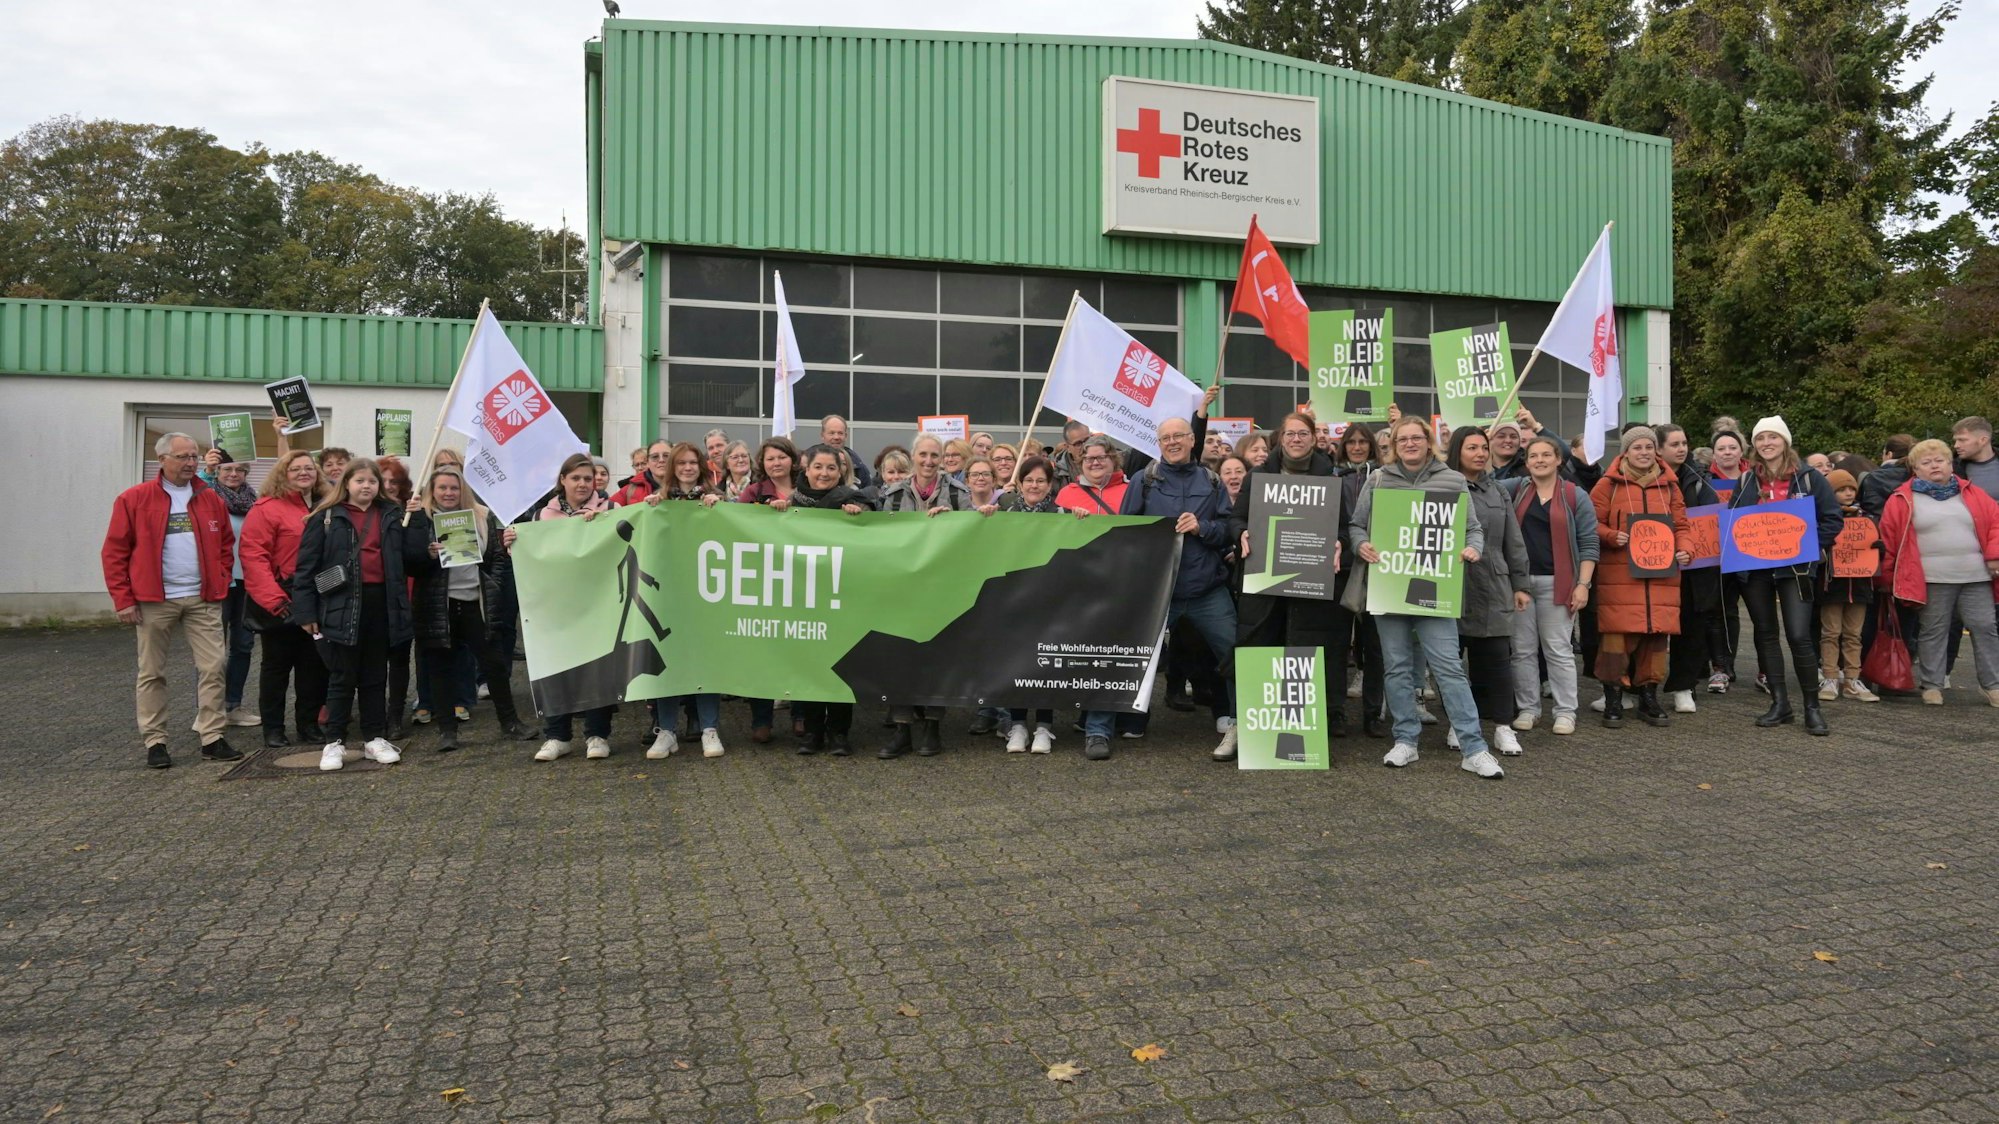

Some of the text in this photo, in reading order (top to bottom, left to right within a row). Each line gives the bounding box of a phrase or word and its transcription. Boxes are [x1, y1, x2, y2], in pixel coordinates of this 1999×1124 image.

[1183, 111, 1302, 143] Deutsches
[1183, 136, 1249, 162] Rotes
[1183, 161, 1249, 186] Kreuz
[1124, 183, 1301, 206] Kreisverband Rheinisch-Bergischer Kreis e.V.
[1342, 317, 1384, 341] NRW
[1333, 341, 1384, 364] BLEIB
[1462, 331, 1500, 355] NRW
[1456, 351, 1505, 377] BLEIB
[1317, 365, 1384, 388] SOZIAL!
[1444, 372, 1508, 399] SOZIAL!
[273, 384, 301, 398] MACHT!
[1115, 381, 1149, 405] caritas
[376, 412, 410, 422] APPLAUS!
[1079, 401, 1098, 416] Der
[1097, 410, 1136, 434] Mensch
[1081, 388, 1158, 432] Caritas RheinBe
[220, 418, 241, 429] GEHT!
[482, 411, 505, 442] aritas
[1263, 482, 1327, 506] MACHT!
[441, 515, 469, 528] IMMER!
[1410, 500, 1458, 526] NRW
[1398, 525, 1455, 552] BLEIB
[697, 539, 844, 610] GEHT!
[1378, 550, 1454, 578] SOZIAL!
[725, 617, 828, 641] ...NICHT MEHR
[1037, 642, 1059, 652] Freie
[1060, 643, 1135, 655] Wohlfahrtspflege
[1272, 656, 1316, 680] NRW
[1014, 677, 1139, 692] www.nrw-bleib-sozial
[1263, 682, 1317, 705] BLEIB
[1246, 707, 1318, 731] SOZIAL!
